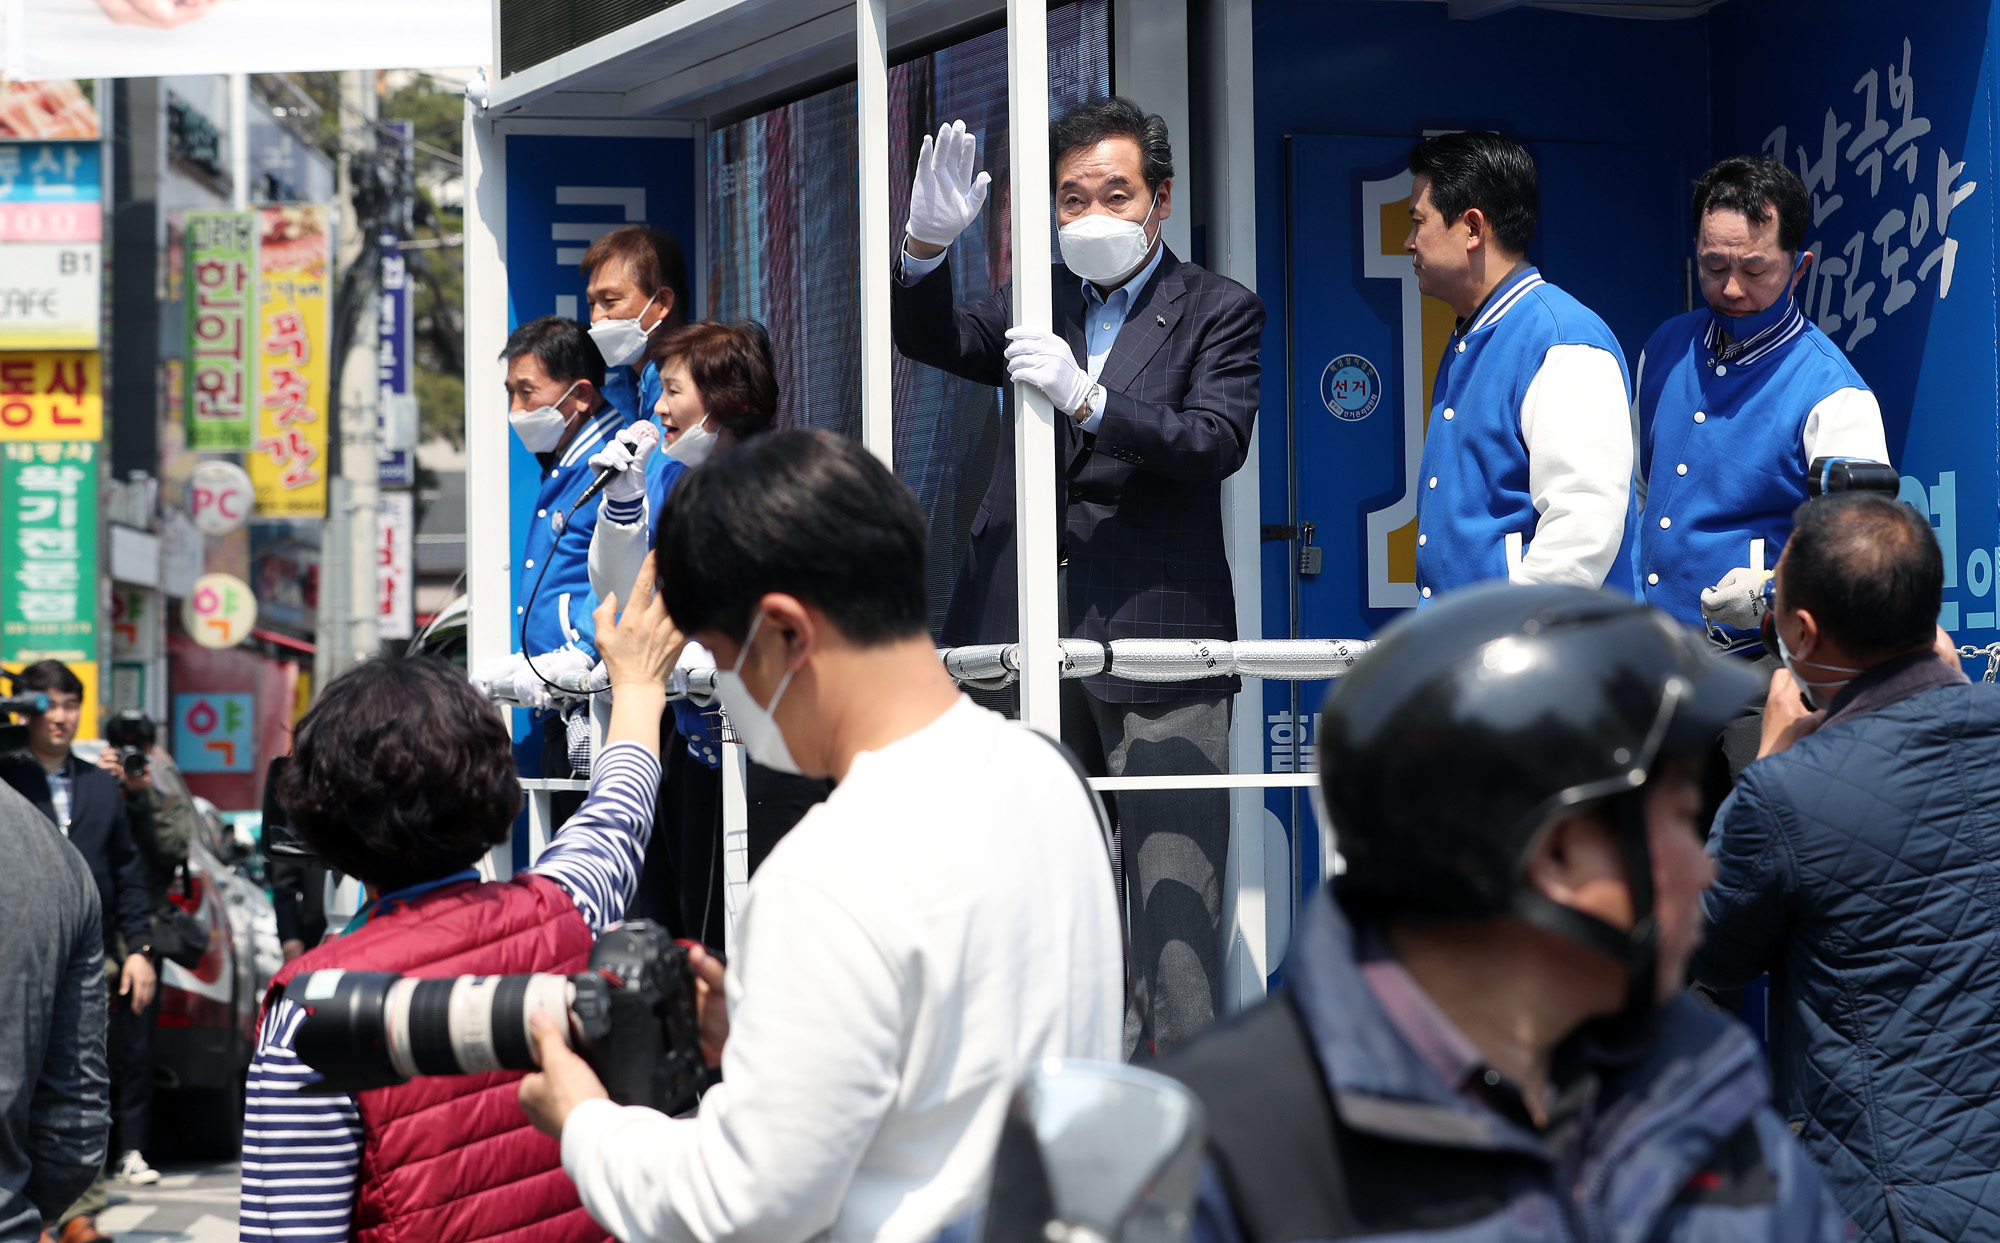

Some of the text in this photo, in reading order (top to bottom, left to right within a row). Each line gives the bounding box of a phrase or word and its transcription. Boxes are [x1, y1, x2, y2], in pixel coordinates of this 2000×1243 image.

[60, 251, 92, 273] B1
[194, 257, 248, 417] 한의원
[1333, 379, 1366, 399] 선거
[191, 487, 239, 519] PC
[193, 586, 241, 642] 약
[186, 700, 242, 767] 약
